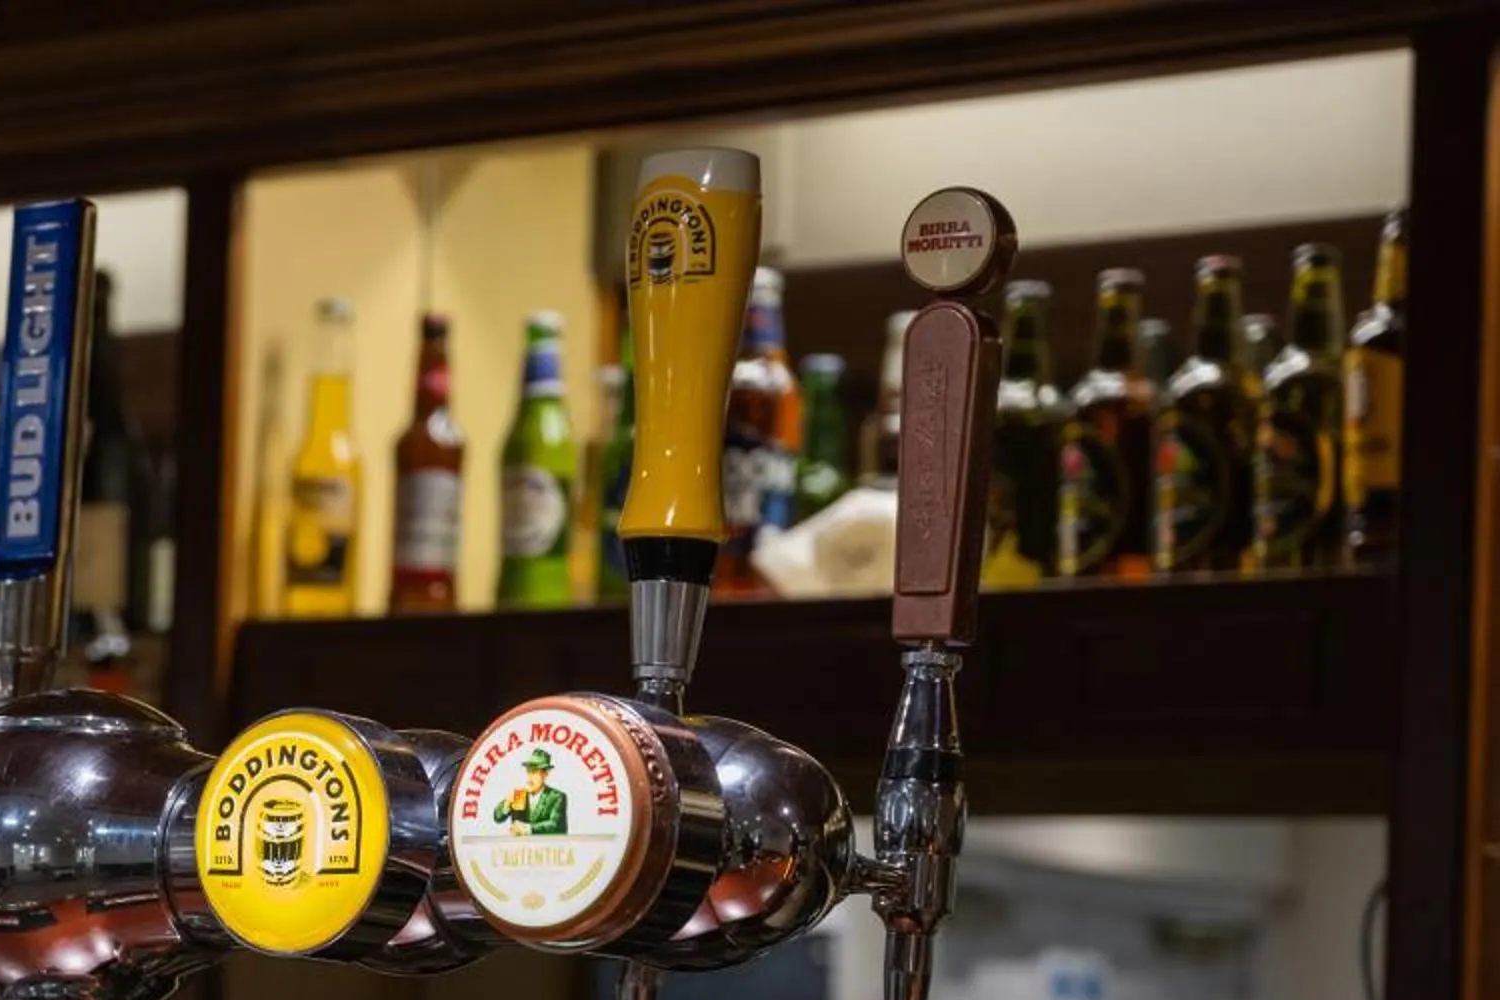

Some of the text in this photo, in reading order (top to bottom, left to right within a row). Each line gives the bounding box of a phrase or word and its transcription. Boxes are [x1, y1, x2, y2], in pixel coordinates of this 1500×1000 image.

[906, 234, 984, 254] MORETTI
[919, 220, 971, 237] BIRRA
[6, 234, 60, 538] BUD LIGHT
[215, 745, 350, 841] BODDINGTONS
[462, 731, 524, 820] BIRRA
[529, 723, 619, 817] MORETTI
